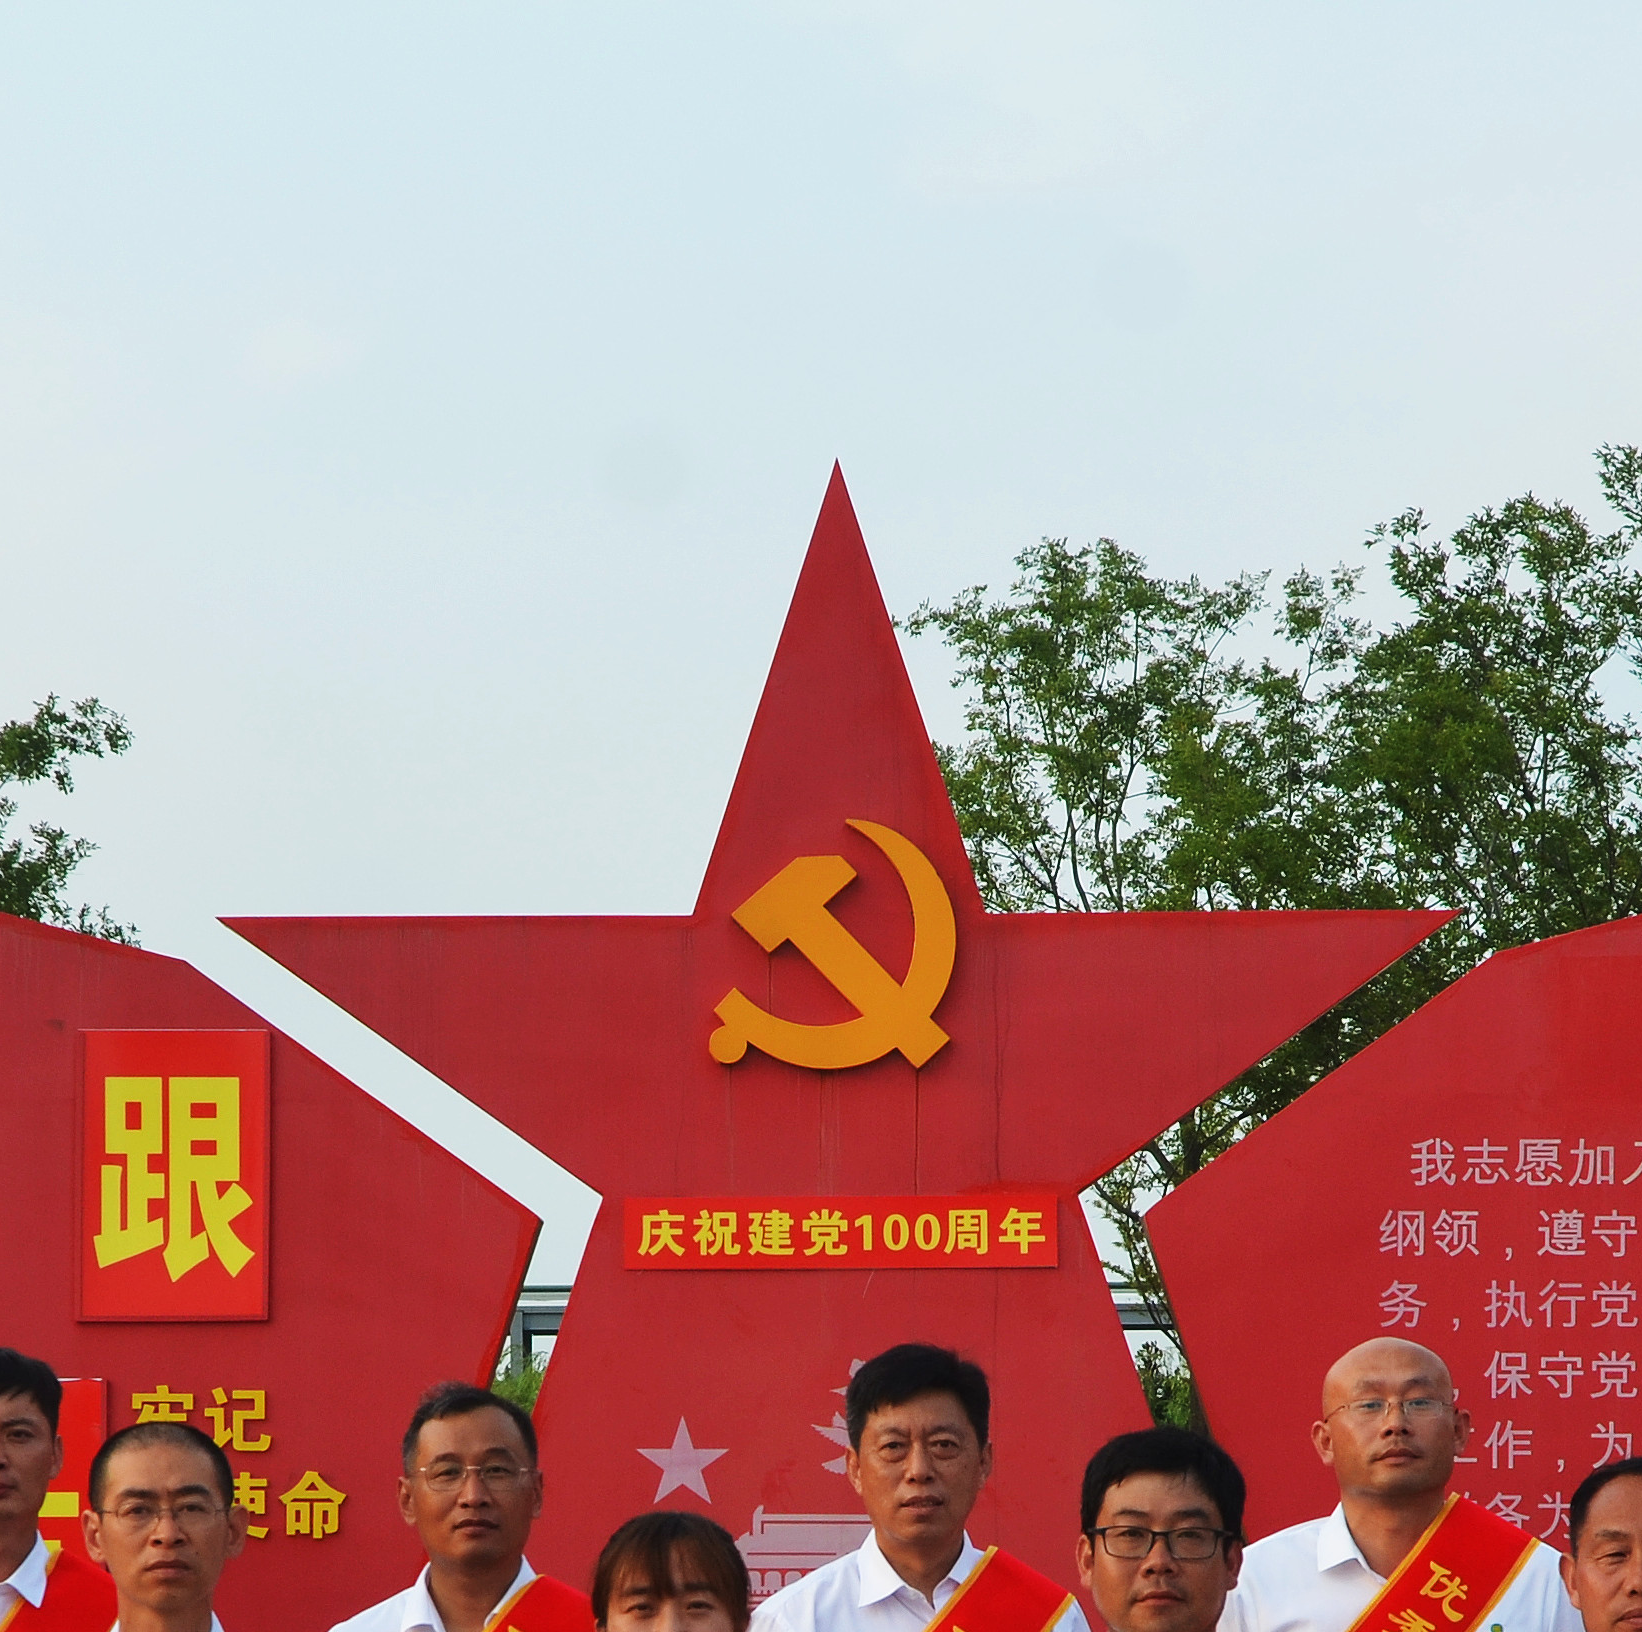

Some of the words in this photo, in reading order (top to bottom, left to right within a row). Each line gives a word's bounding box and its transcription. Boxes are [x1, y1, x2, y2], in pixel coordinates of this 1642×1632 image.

[637, 1207, 1047, 1257] 庆祝建党100周年
